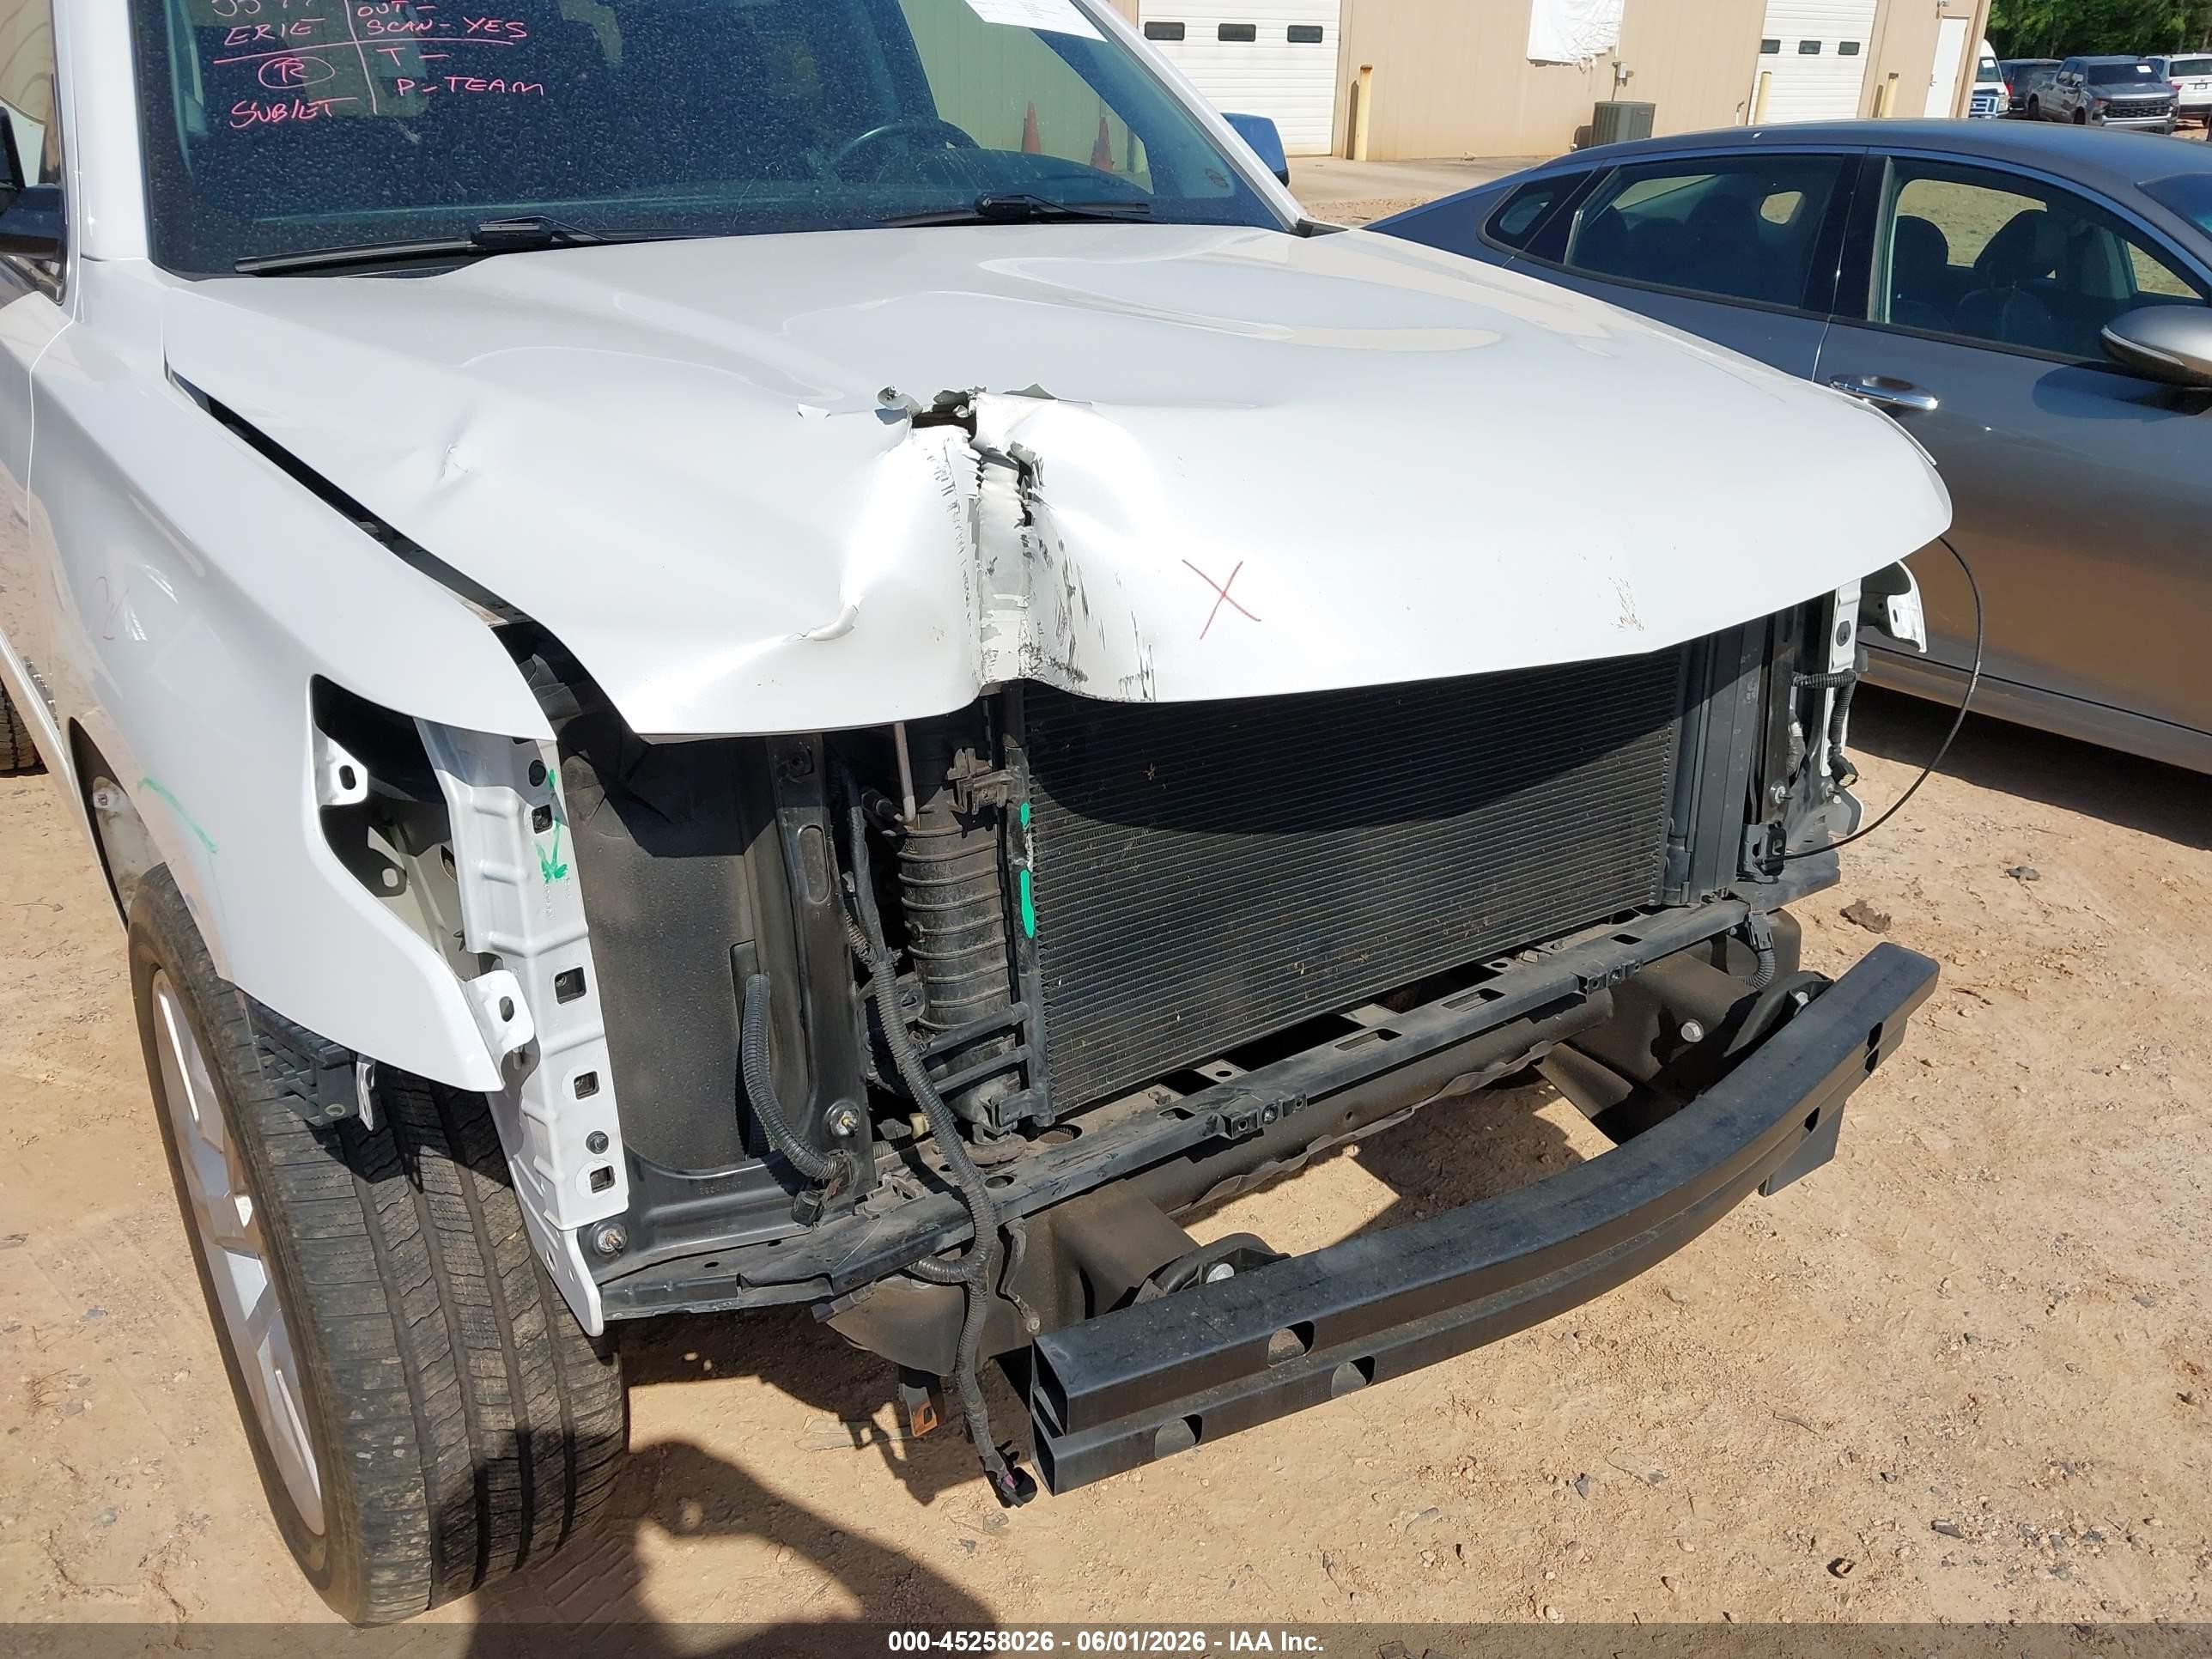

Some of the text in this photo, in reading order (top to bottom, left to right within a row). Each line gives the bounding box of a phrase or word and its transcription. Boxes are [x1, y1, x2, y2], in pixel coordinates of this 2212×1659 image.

[357, 1, 406, 17] OUT
[224, 18, 327, 46] ERIE
[367, 19, 431, 35] SCAN
[462, 16, 527, 39] YES
[397, 78, 414, 96] P
[444, 76, 544, 96] TEAM
